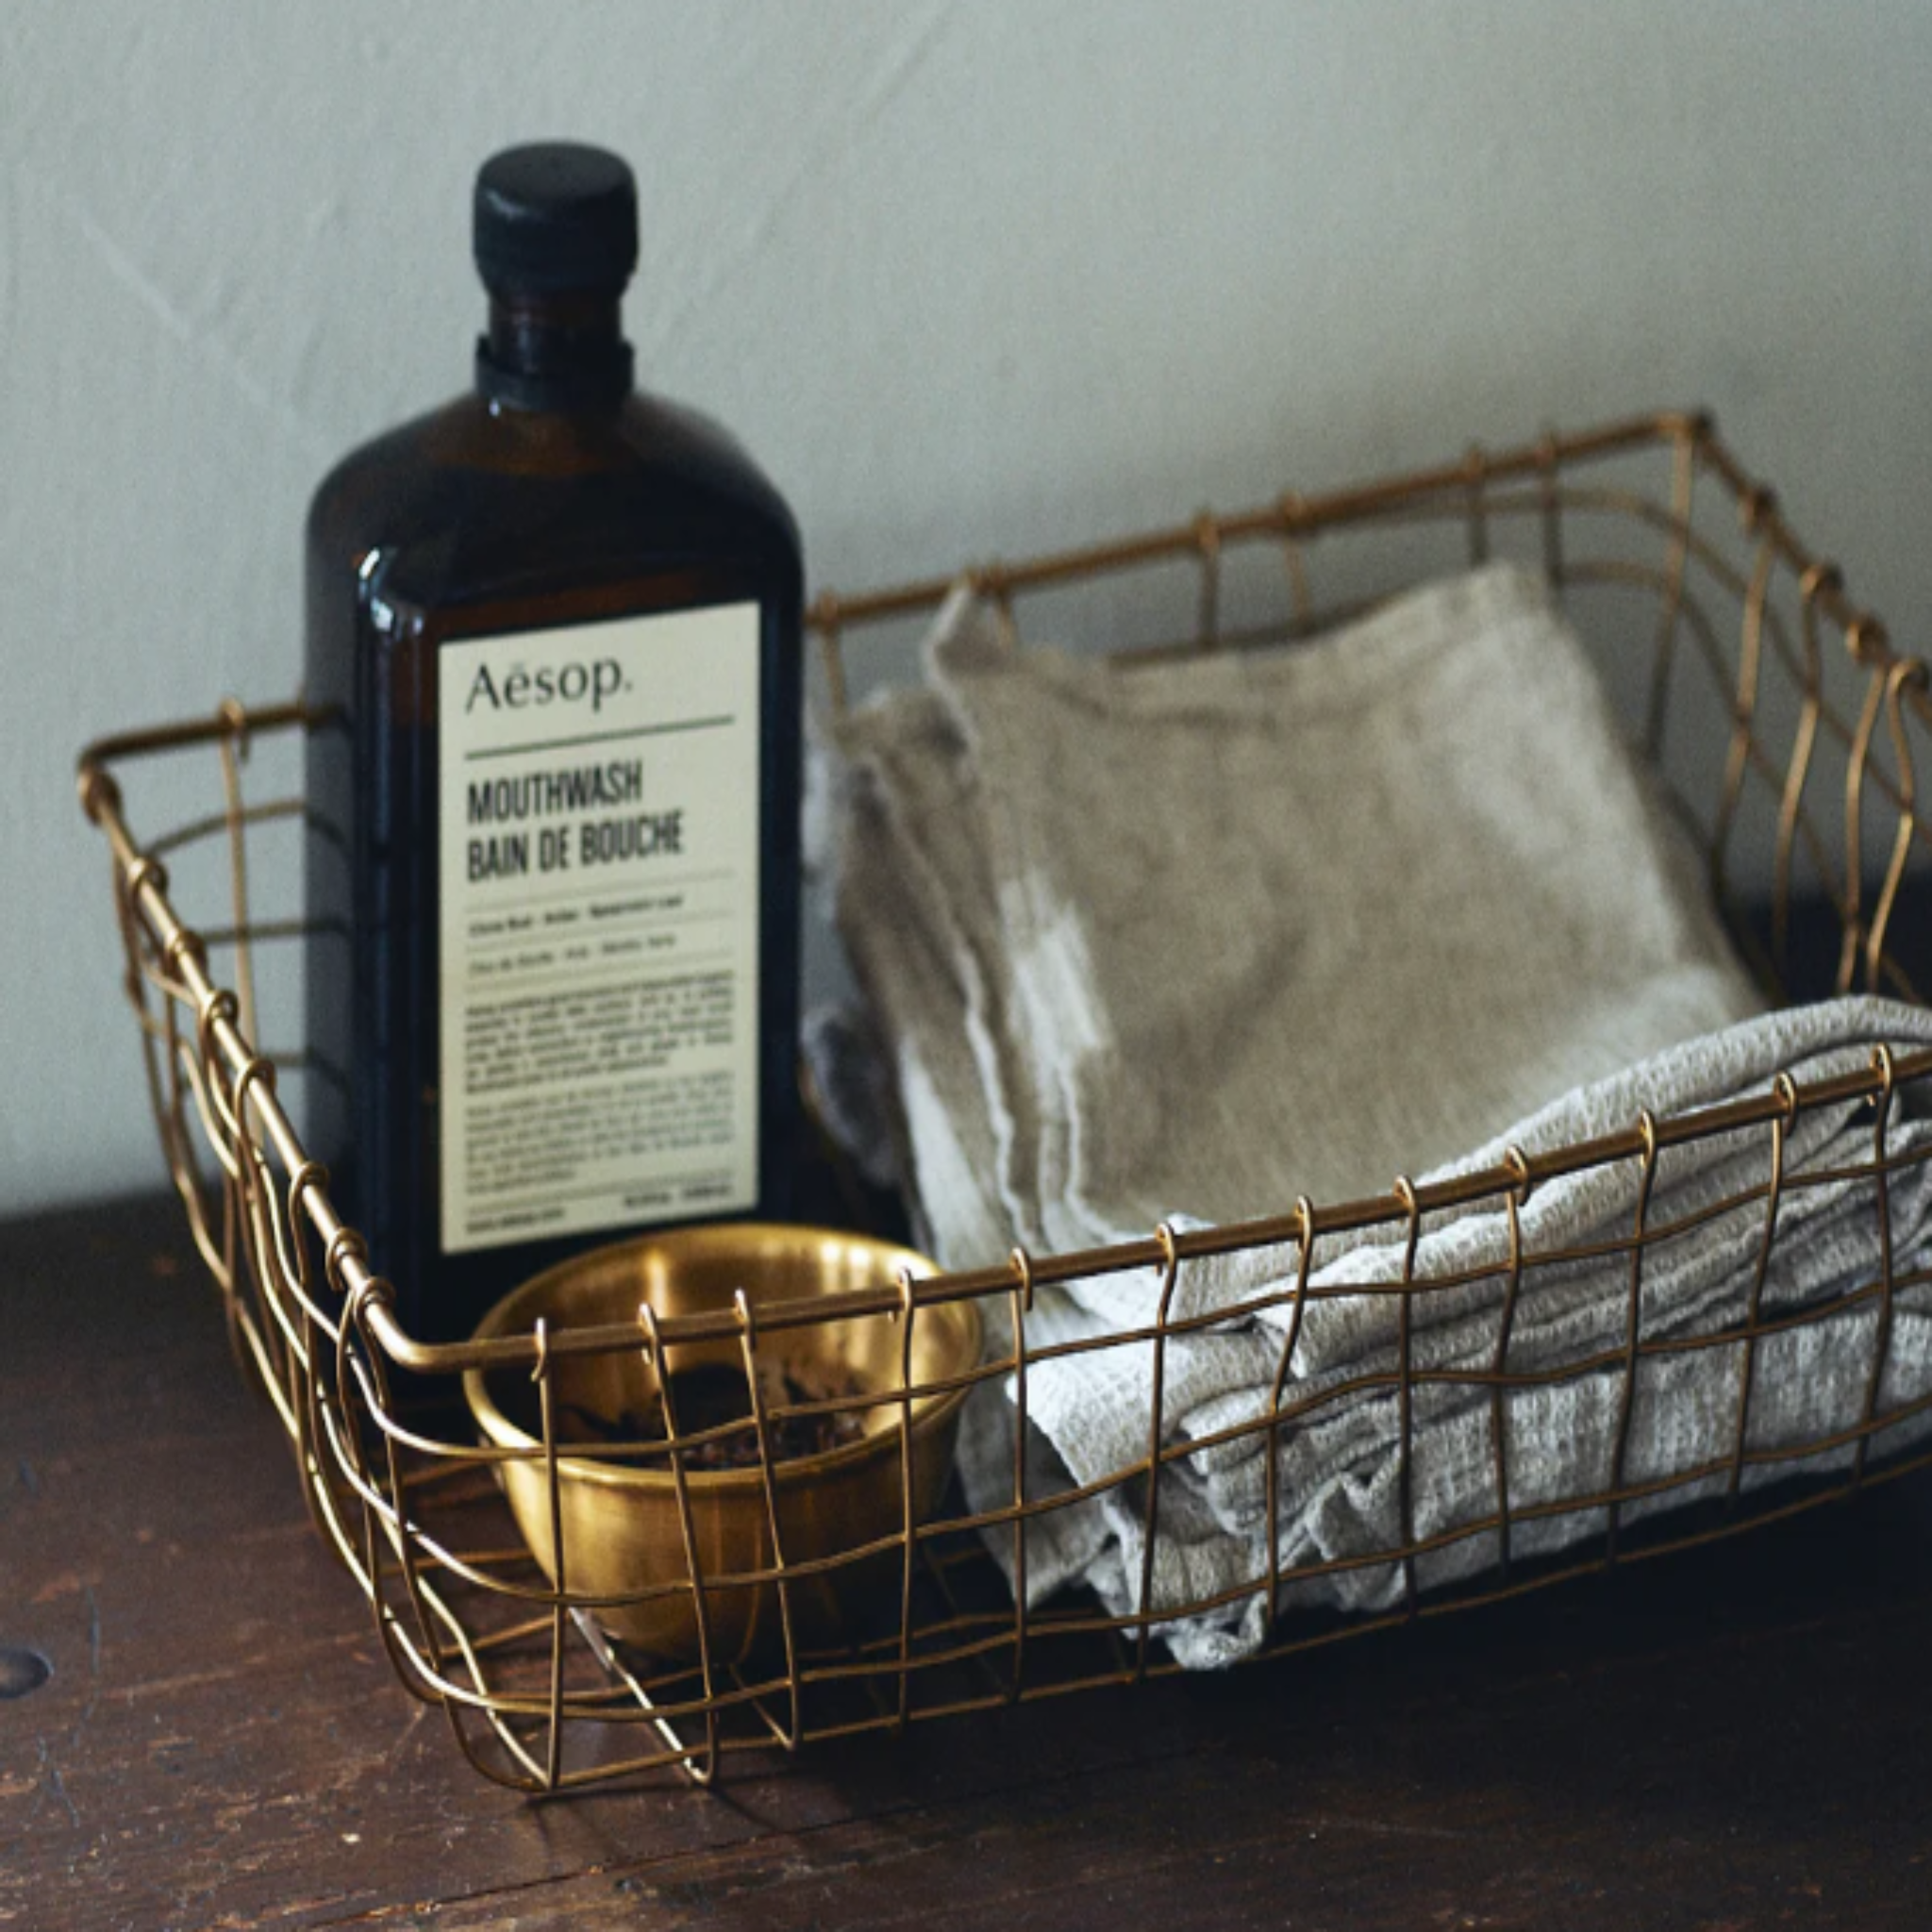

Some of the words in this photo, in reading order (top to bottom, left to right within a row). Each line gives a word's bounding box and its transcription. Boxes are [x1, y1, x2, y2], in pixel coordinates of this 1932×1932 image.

[468, 758, 642, 824] MOUTHWASH
[468, 832, 528, 882] BAIN
[540, 824, 570, 873] DE
[580, 808, 683, 867] BOUCHE
